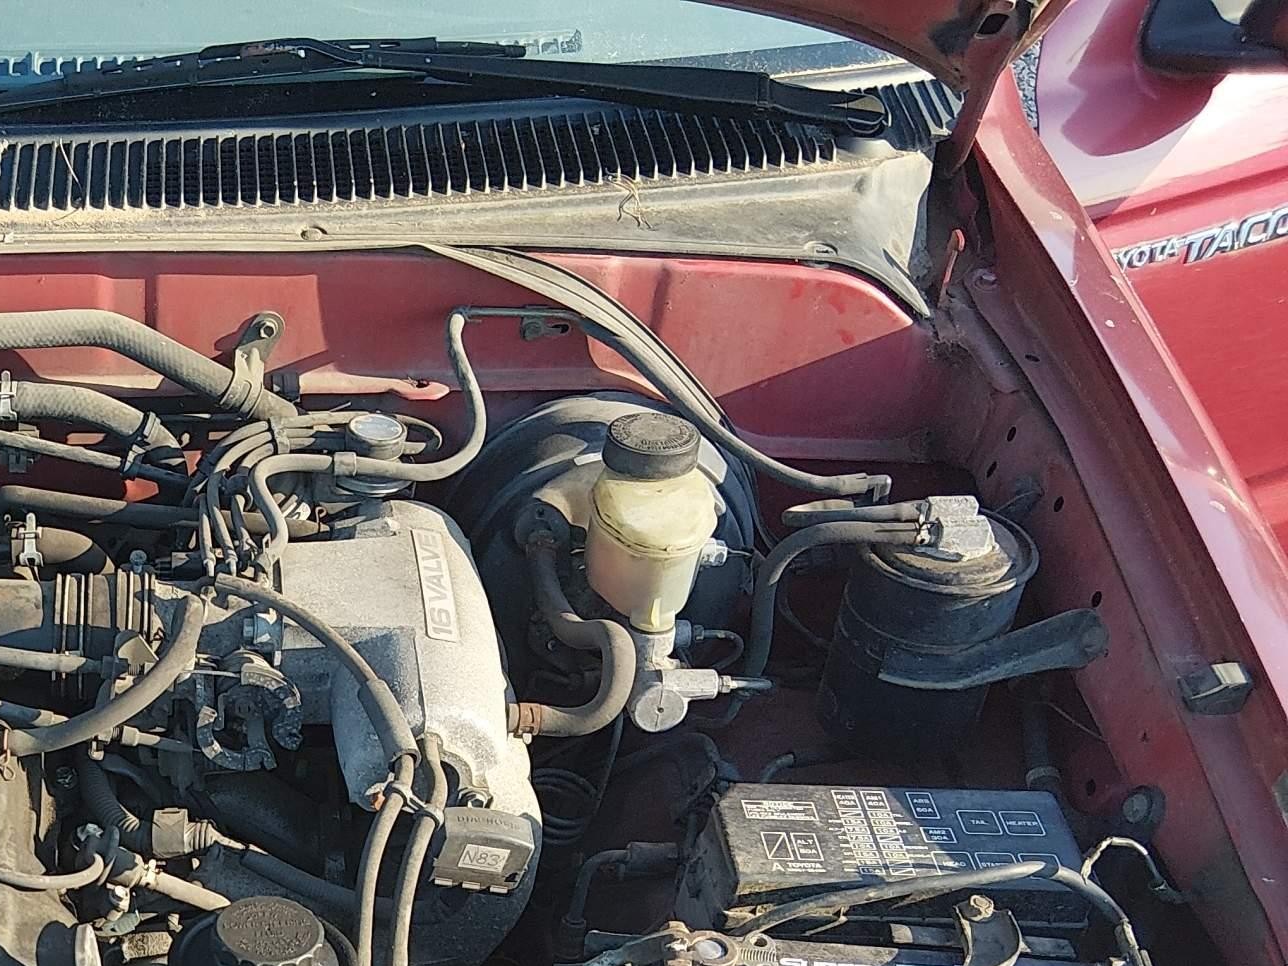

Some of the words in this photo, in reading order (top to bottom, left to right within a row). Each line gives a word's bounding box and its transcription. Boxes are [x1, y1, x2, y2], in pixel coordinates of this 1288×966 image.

[417, 532, 448, 601] VALVE
[429, 606, 453, 635] 16
[461, 849, 501, 868] N83
